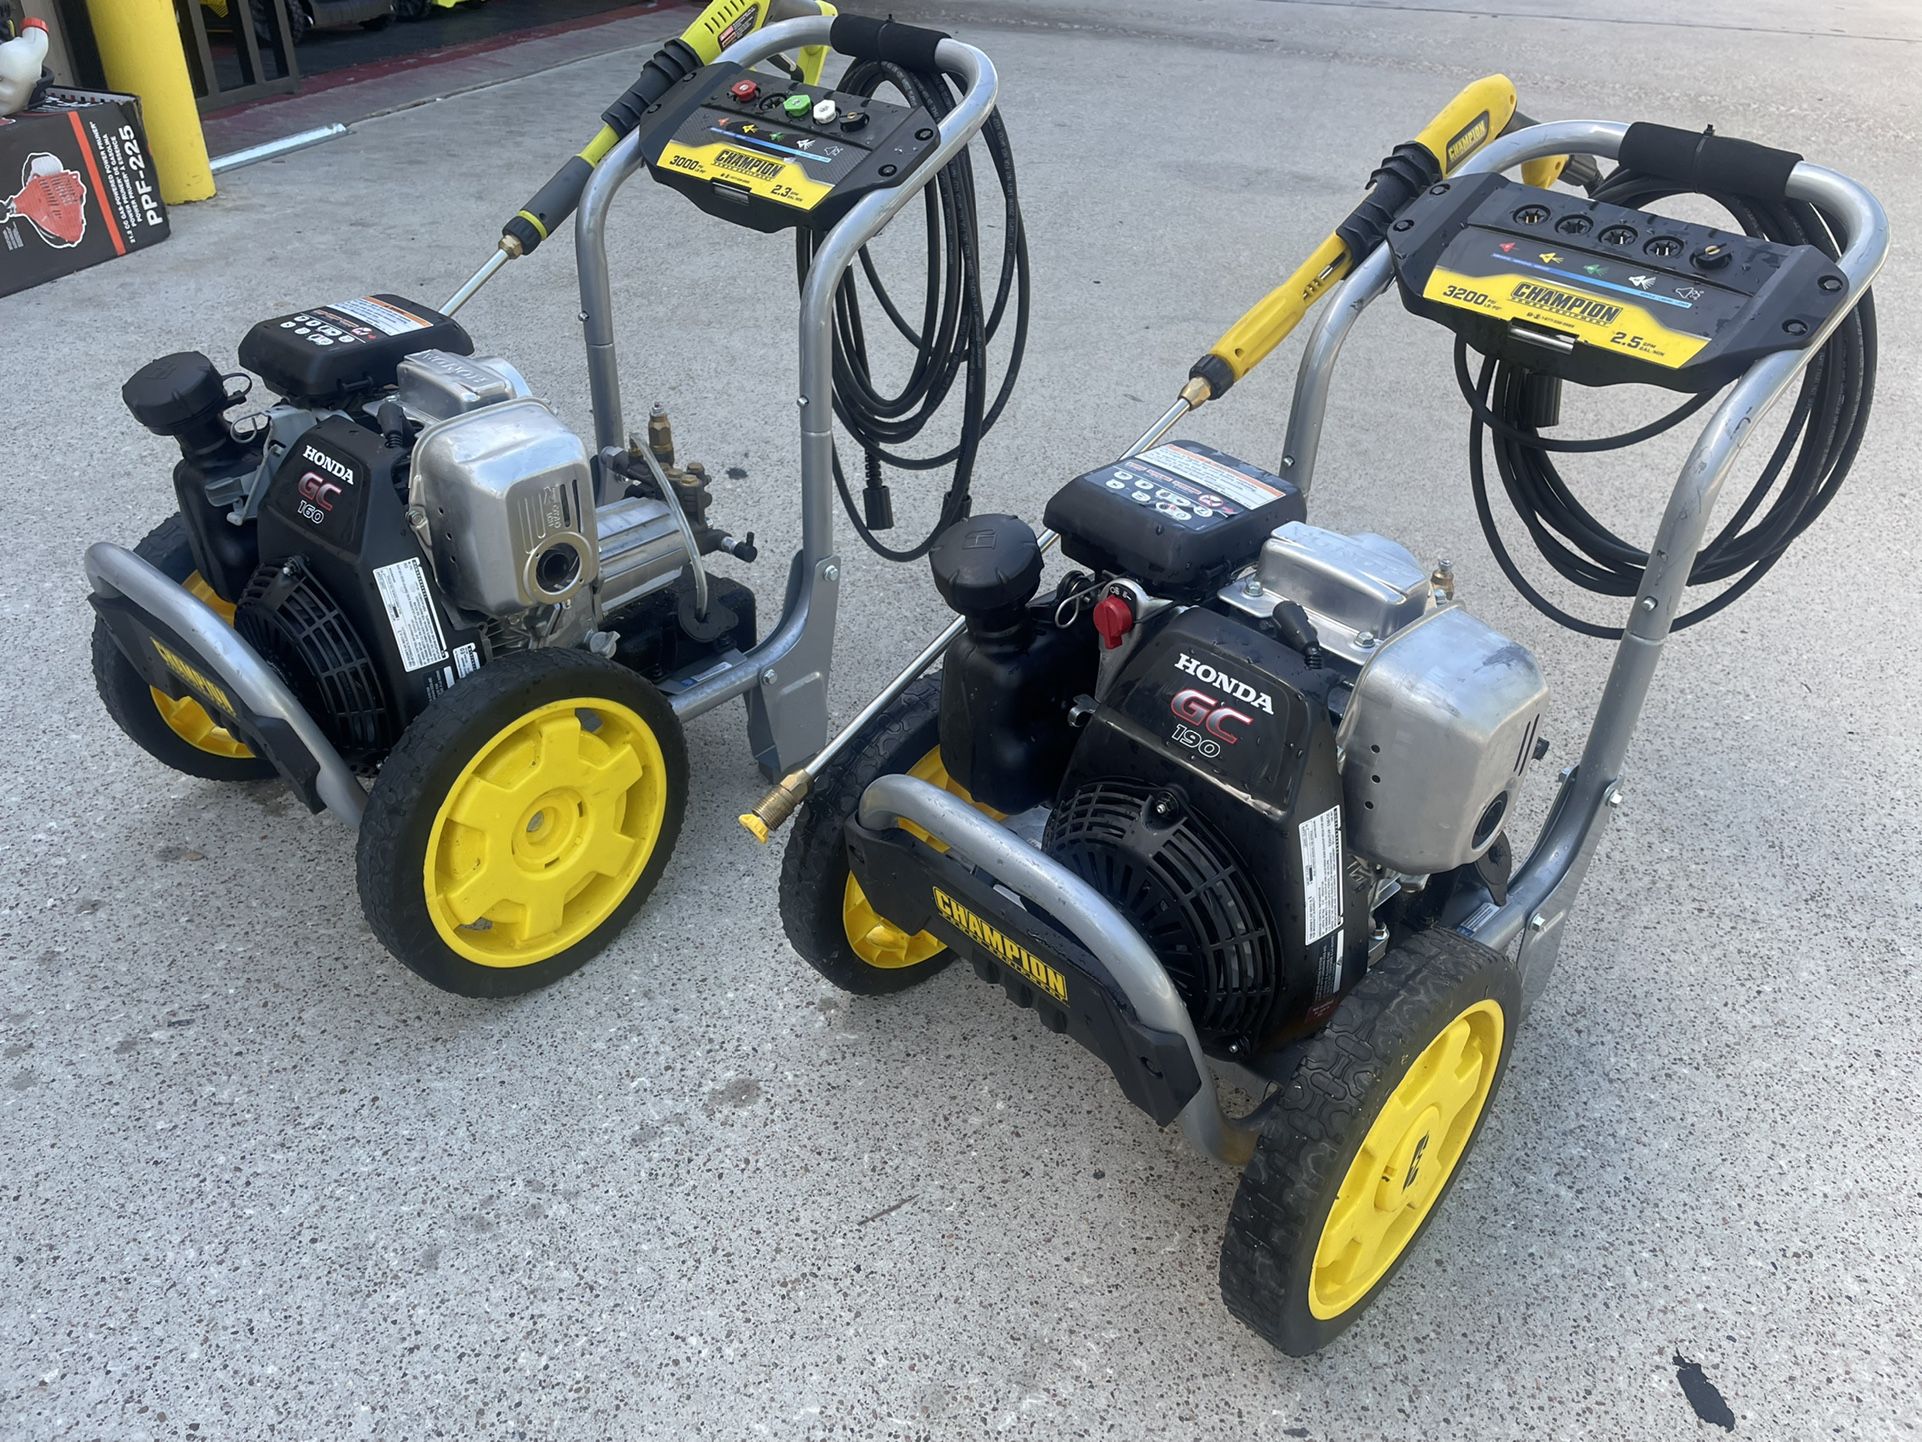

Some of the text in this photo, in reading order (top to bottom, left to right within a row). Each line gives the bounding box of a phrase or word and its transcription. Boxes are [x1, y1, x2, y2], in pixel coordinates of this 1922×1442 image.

[102, 133, 115, 166] GASOLINA
[110, 136, 124, 166] ESSENCE
[1448, 119, 1486, 162] CHAMPION
[100, 150, 112, 174] POWER
[113, 166, 120, 176] DE
[118, 124, 163, 226] PPF-225
[669, 155, 699, 171] 3000
[715, 149, 785, 178] CHAMPION
[108, 174, 127, 220] GAS-POWERED
[770, 184, 791, 198] 2.3
[124, 204, 137, 228] POWER
[131, 200, 143, 223] POWER
[1442, 285, 1489, 306] 3200
[1512, 283, 1621, 323] CHAMPION
[1610, 331, 1644, 350] 2.5
[302, 445, 354, 485] HONDA
[298, 471, 342, 512] GC
[297, 500, 324, 524] 160
[1174, 653, 1274, 715] HONDA
[1170, 688, 1254, 744] GC
[1171, 723, 1221, 758] 190
[934, 887, 1067, 999] CHAMPION
